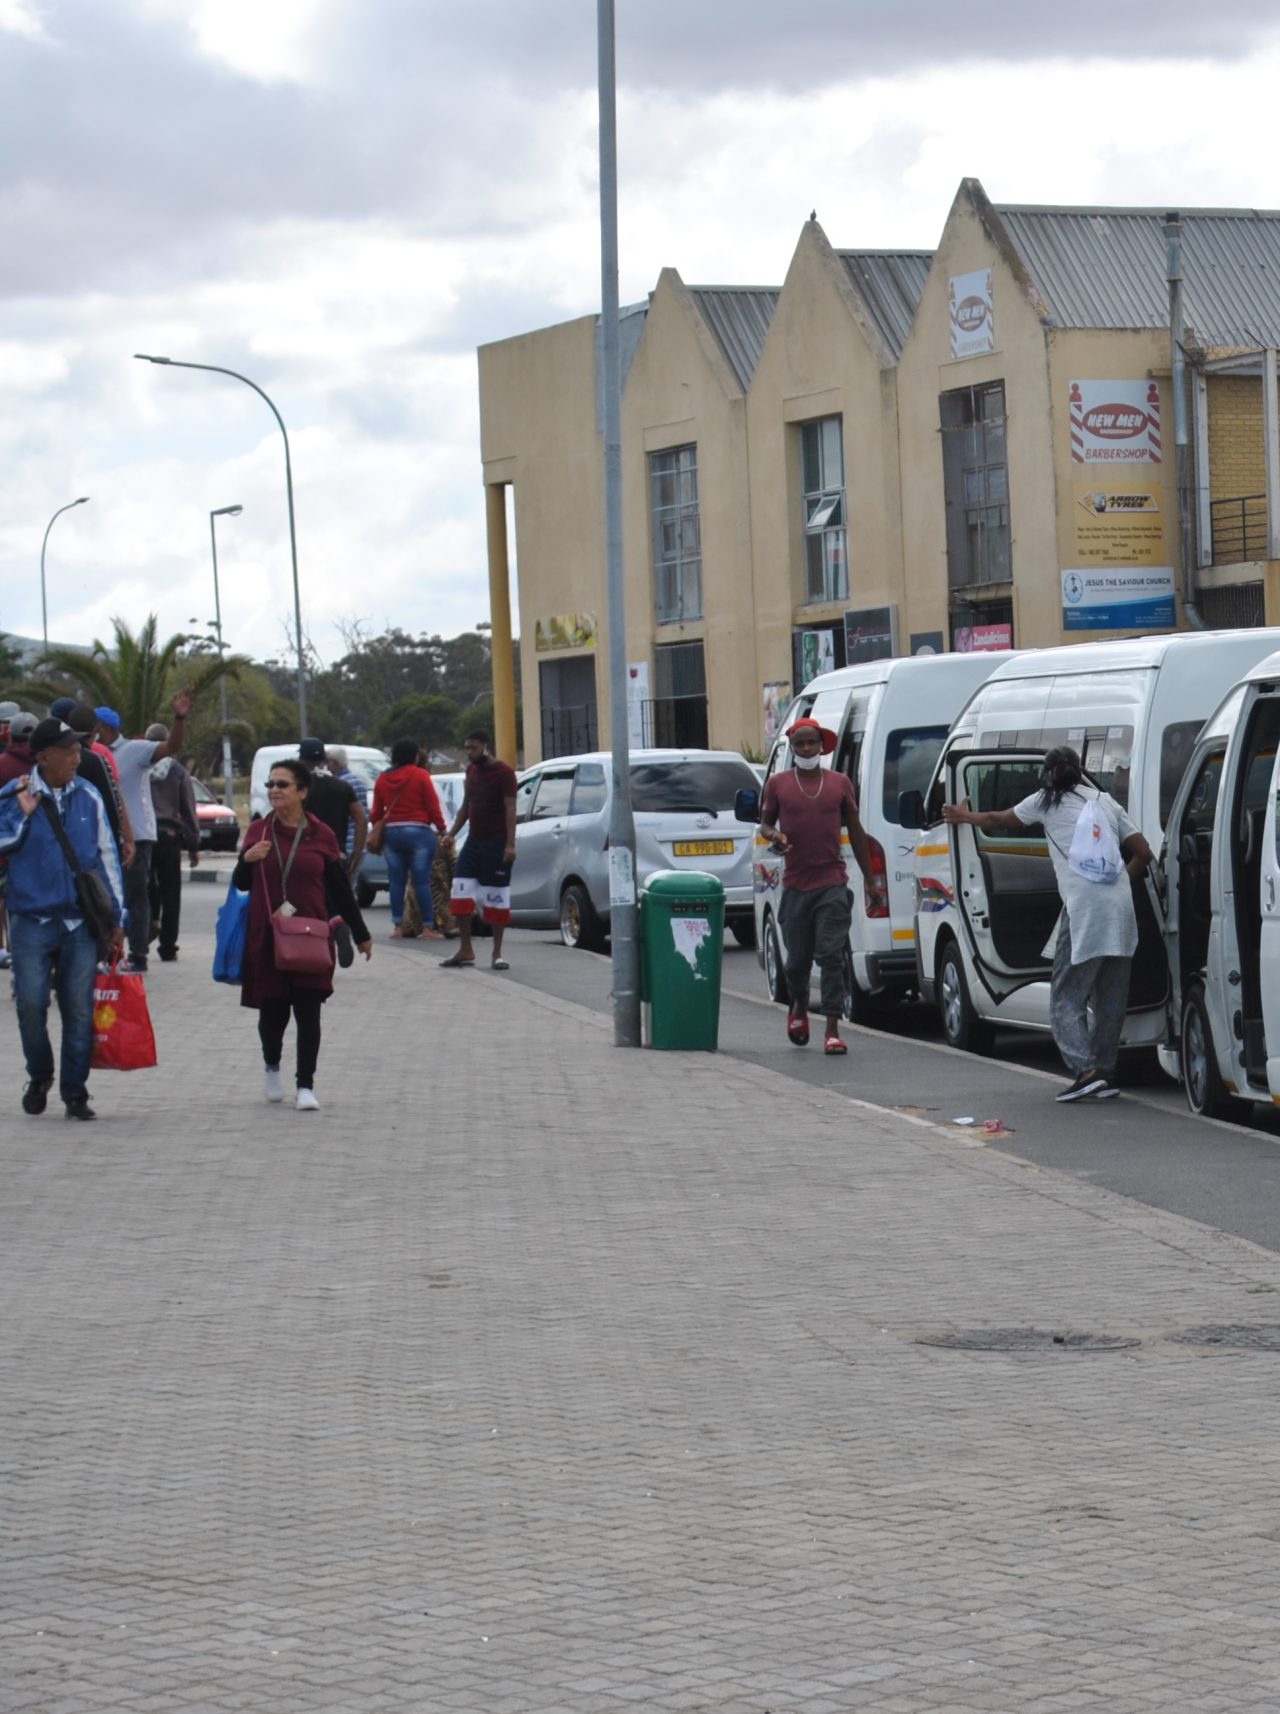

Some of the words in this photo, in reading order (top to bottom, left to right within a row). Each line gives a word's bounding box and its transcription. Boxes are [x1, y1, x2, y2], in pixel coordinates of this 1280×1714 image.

[1087, 413, 1115, 427] NEW
[1116, 413, 1143, 427] MEN
[1085, 448, 1148, 460] BARBERSHOP
[1085, 579, 1104, 587] JESUS
[1118, 578, 1145, 586] SAVIOUR
[1146, 577, 1171, 585] CHURCH
